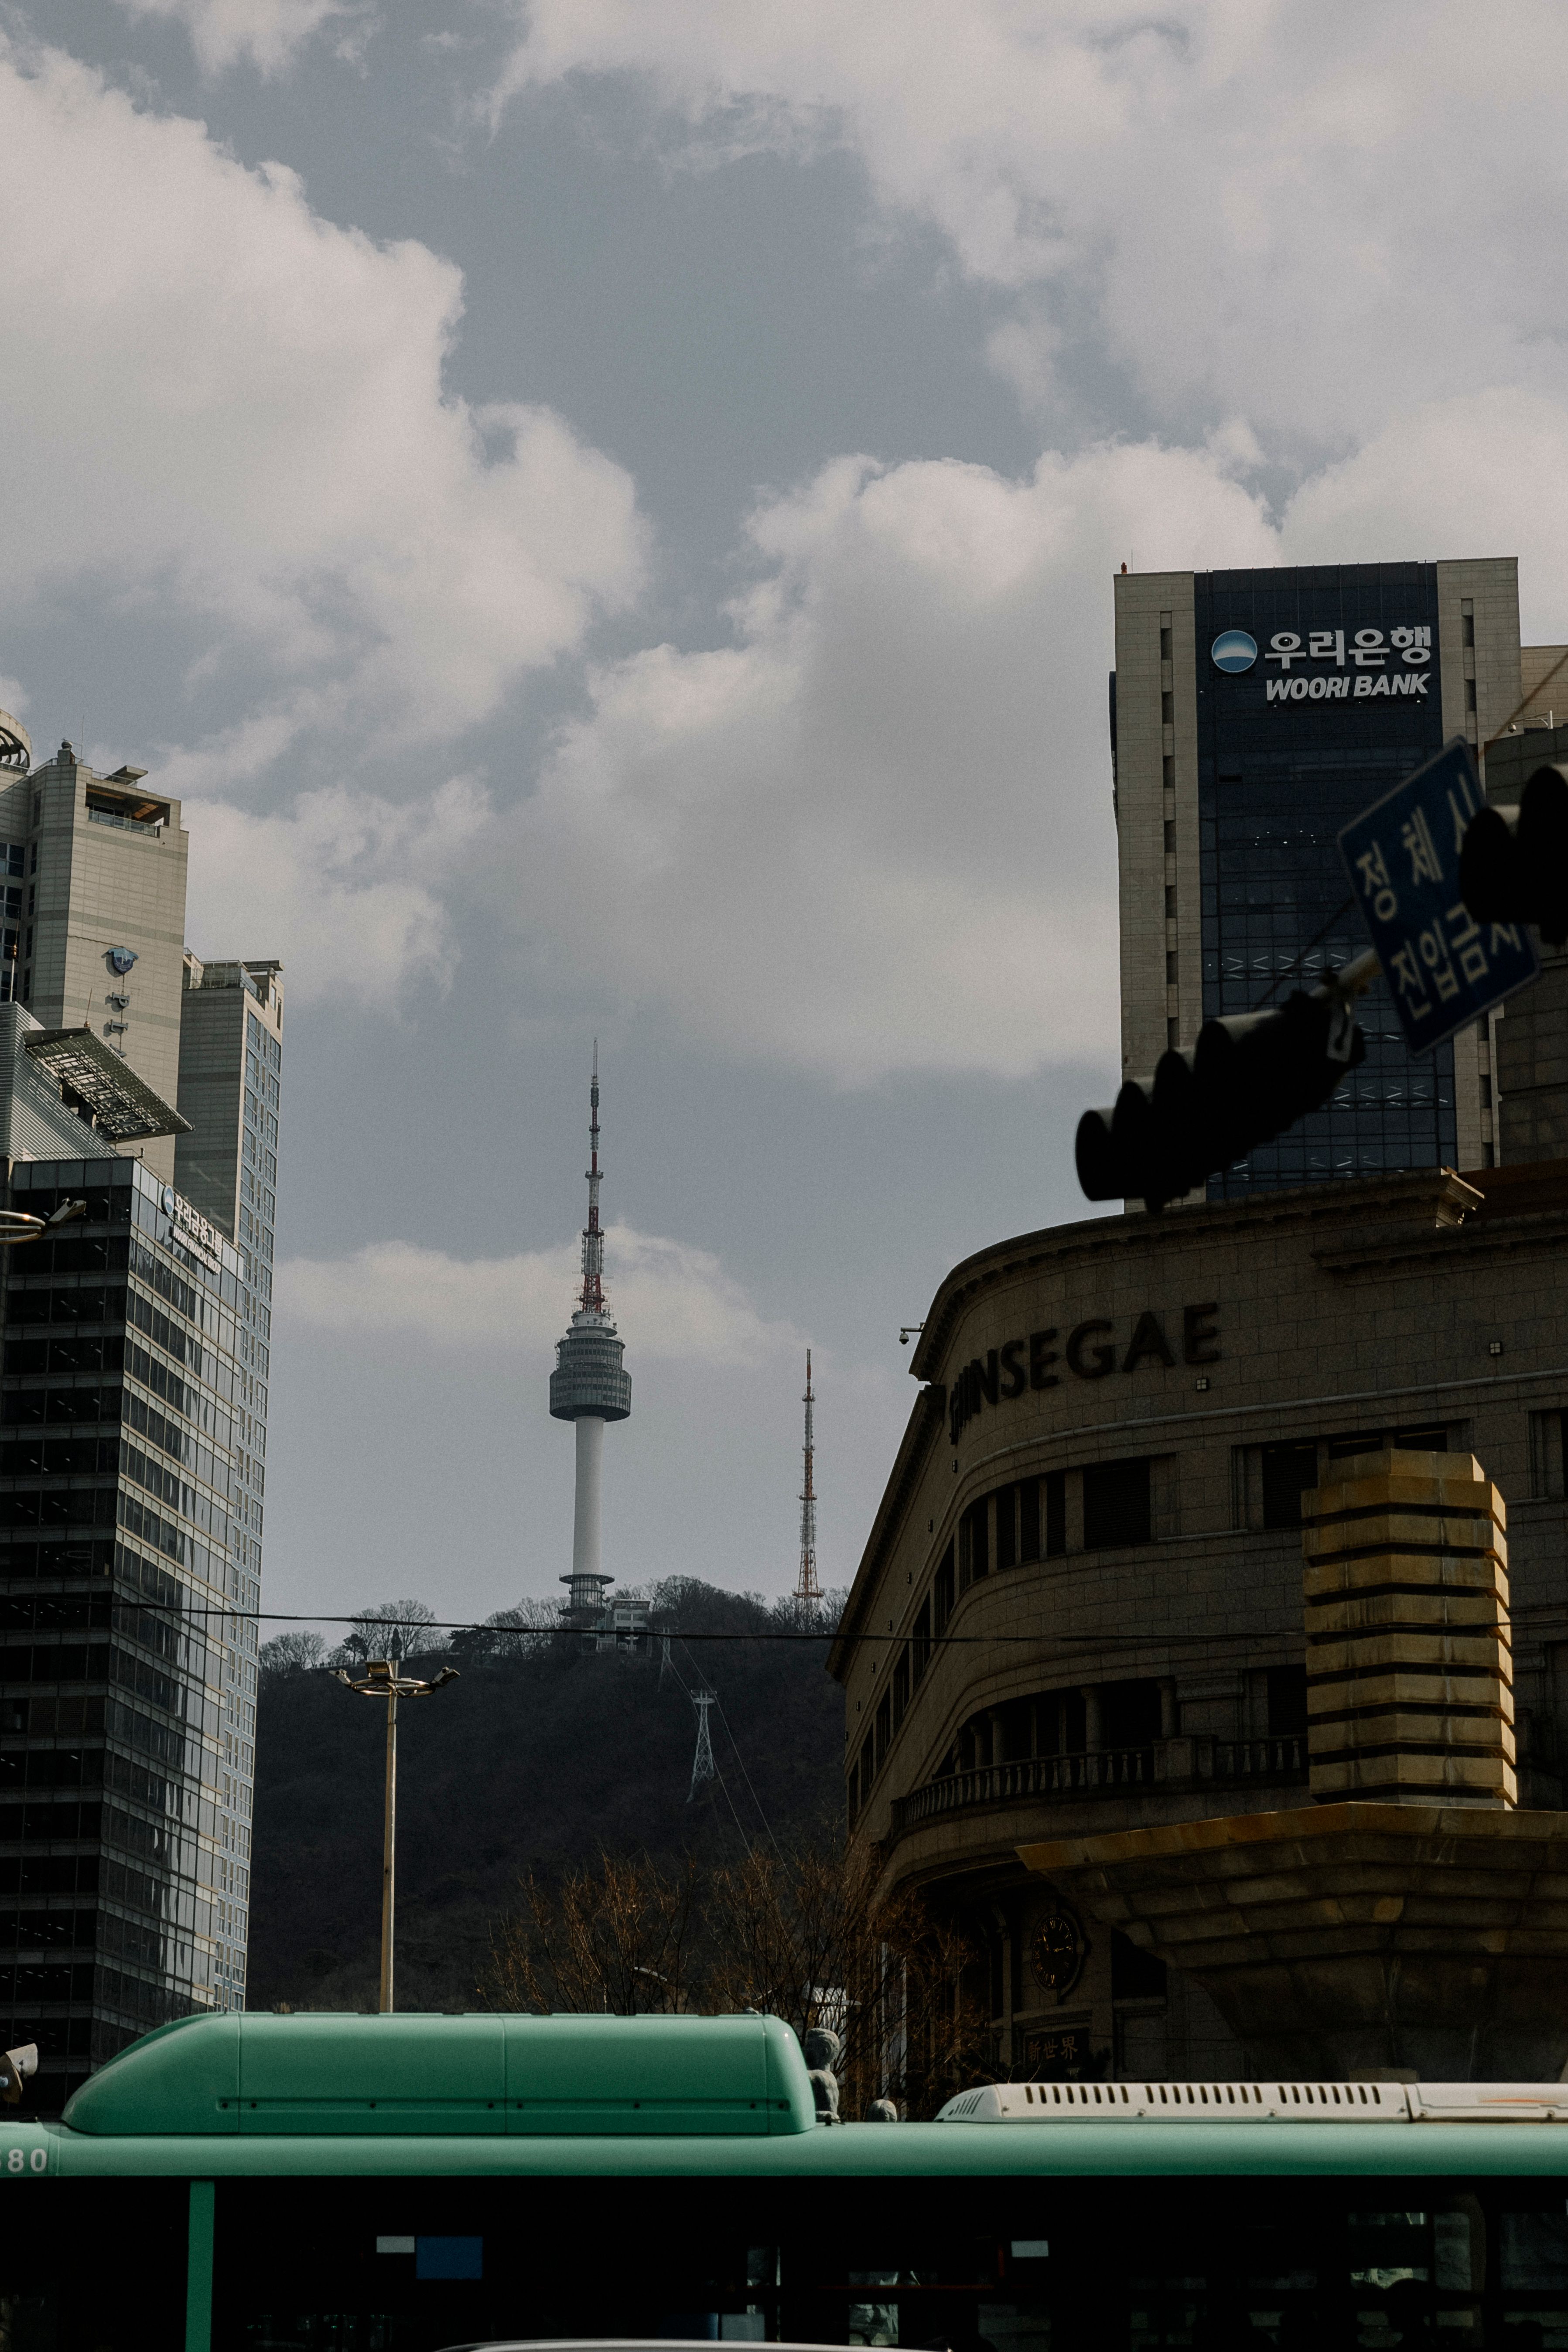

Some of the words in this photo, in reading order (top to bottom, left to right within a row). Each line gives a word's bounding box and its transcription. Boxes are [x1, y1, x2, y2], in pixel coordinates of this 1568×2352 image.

[1264, 626, 1431, 670] 우리은행
[1266, 677, 1350, 701] WOORI
[1353, 673, 1431, 697] BANK
[173, 1224, 187, 1248] WOORI
[187, 1239, 208, 1265] FINANCIAL
[174, 1195, 223, 1256] 우리금융그룹
[950, 1302, 1220, 1445] NSEGAE
[1028, 2036, 1079, 2063] 新世界
[0, 2148, 47, 2172] 80
